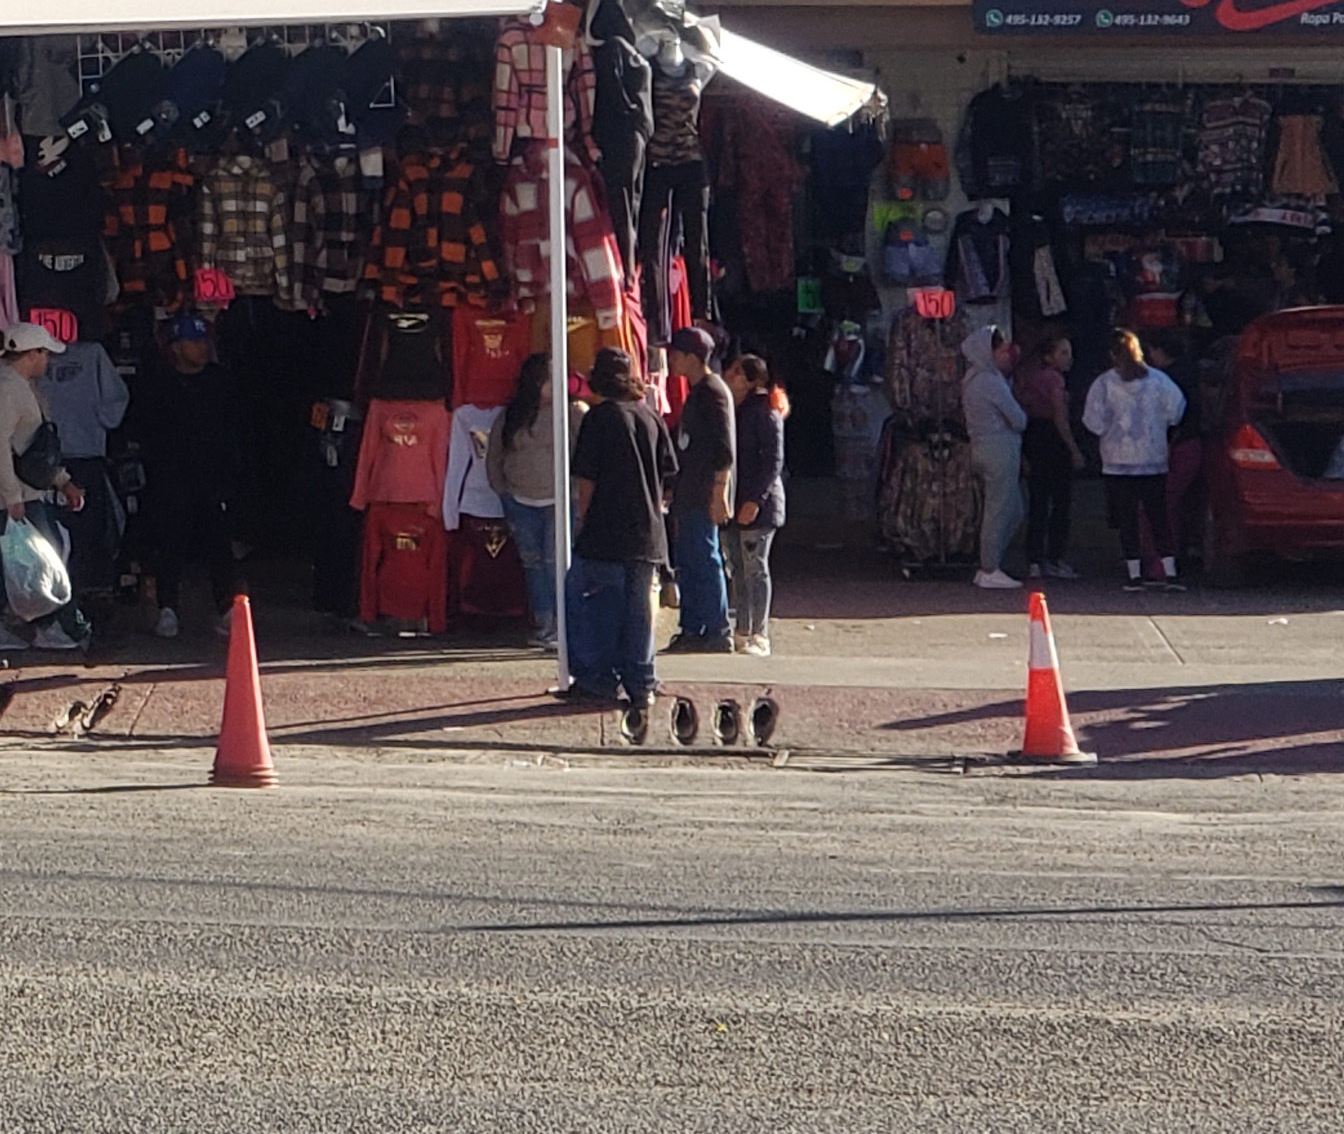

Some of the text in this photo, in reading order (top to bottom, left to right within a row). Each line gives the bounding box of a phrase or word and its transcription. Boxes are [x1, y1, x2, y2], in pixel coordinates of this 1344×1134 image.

[1300, 12, 1330, 26] Ropa
[921, 292, 953, 317] 150
[37, 310, 75, 343] 150
